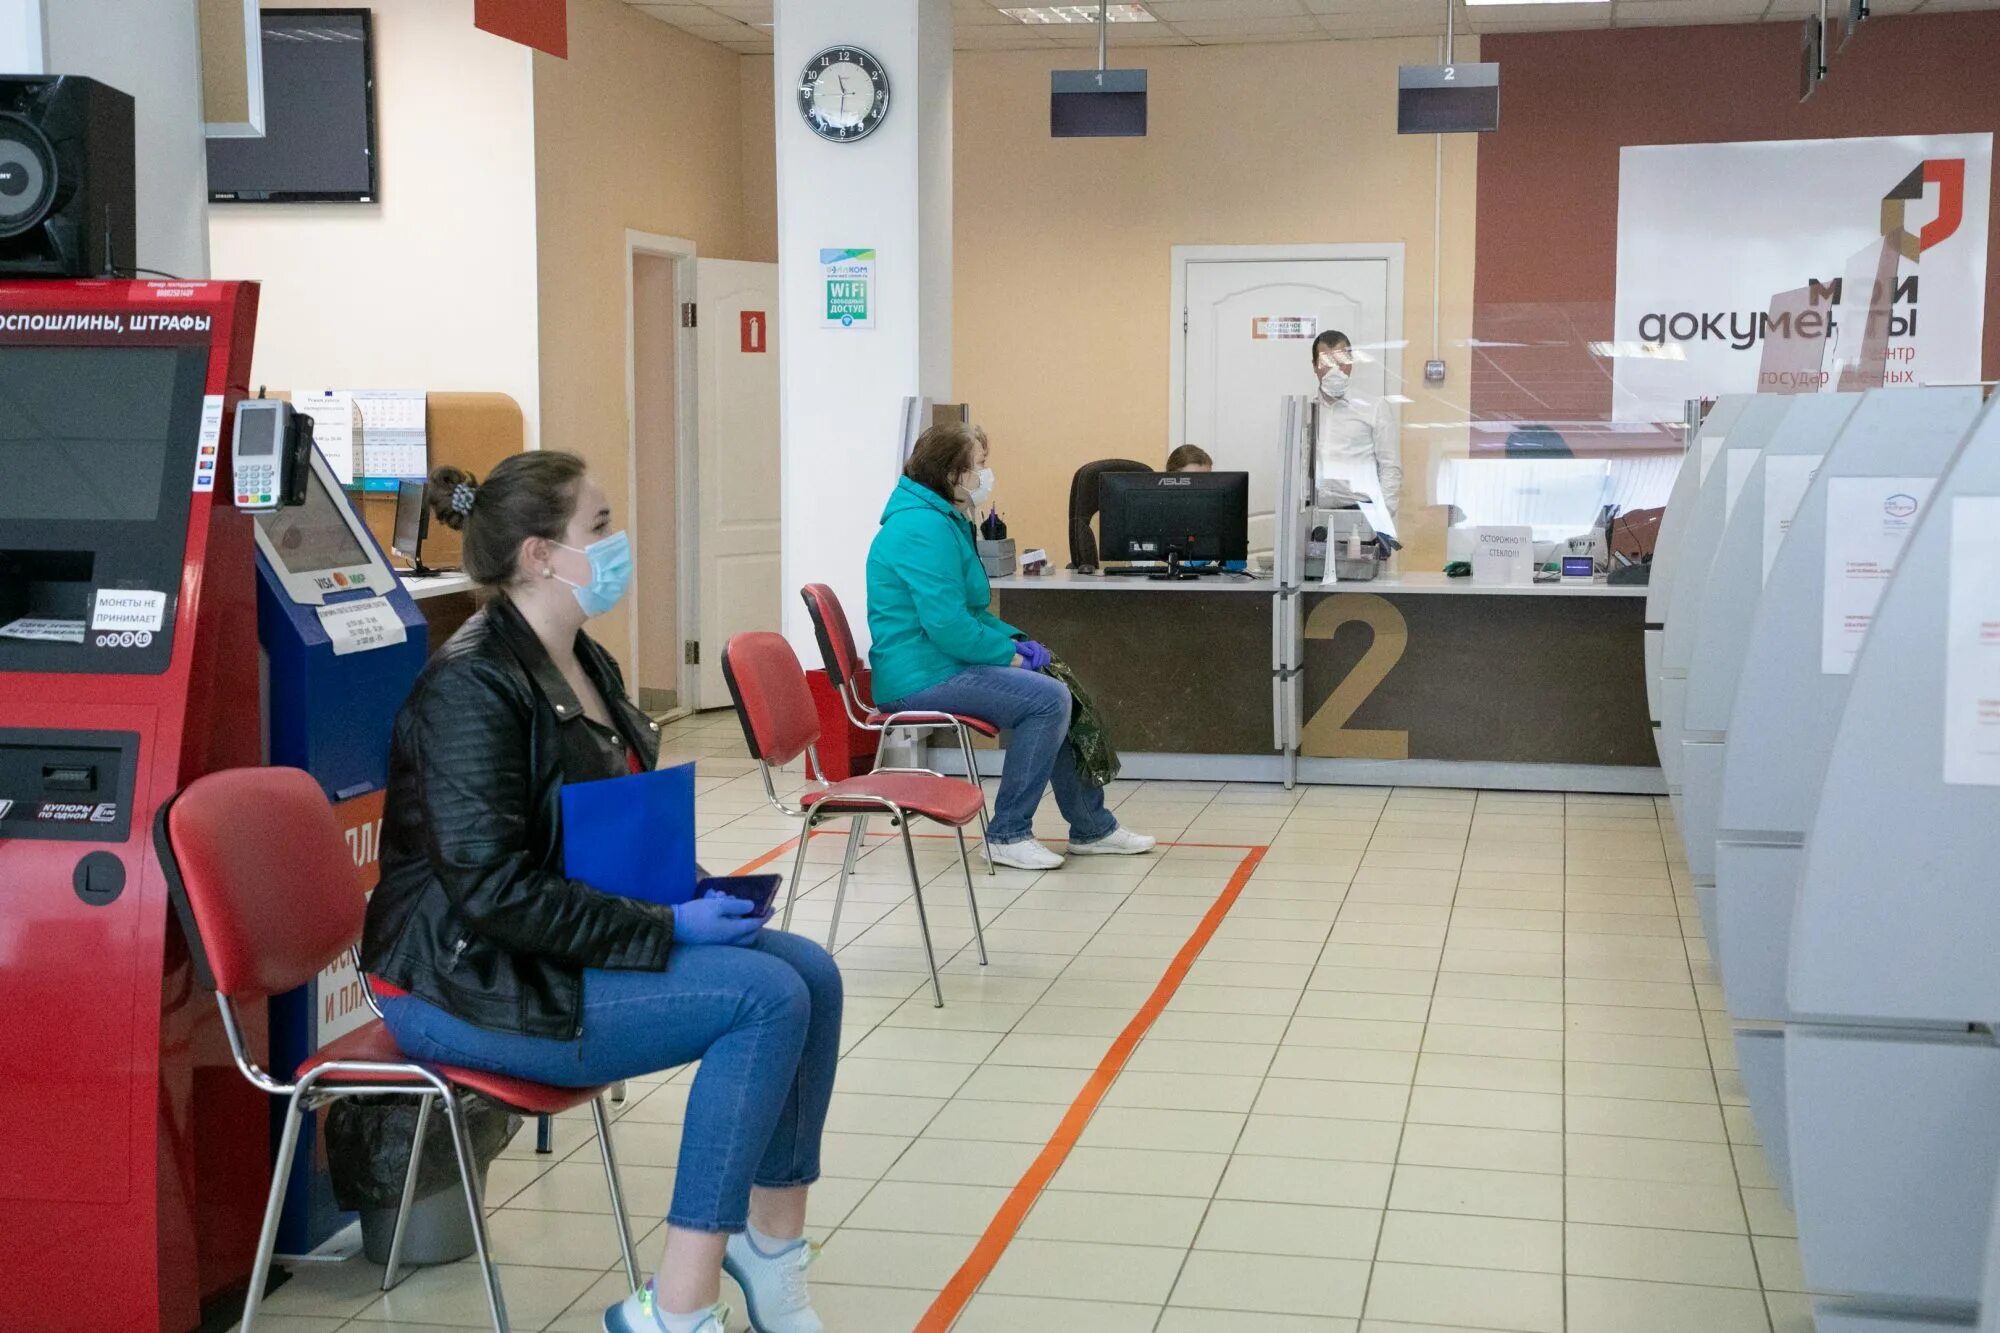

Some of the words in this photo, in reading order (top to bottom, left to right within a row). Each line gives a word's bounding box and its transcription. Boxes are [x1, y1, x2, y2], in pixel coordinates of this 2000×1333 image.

[839, 52, 850, 60] 12
[821, 57, 829, 65] 11
[859, 57, 864, 65] 1
[808, 70, 817, 79] 10
[872, 71, 878, 79] 2
[1444, 67, 1454, 80] 2
[1095, 74, 1102, 85] 1
[804, 90, 810, 98] 9
[876, 90, 882, 99] 3
[809, 109, 815, 117] 8
[872, 109, 877, 118] 4
[840, 128, 845, 136] 6
[830, 283, 864, 297] WiFi
[830, 305, 864, 313] ДОСТУП
[0, 314, 124, 333] СПОШЛИНЫ,
[129, 315, 211, 331] ШТРАФЫ
[1158, 477, 1192, 486] ASUS
[1480, 534, 1519, 544] ОСТОРОЖНО
[314, 577, 336, 590] VISA
[99, 599, 142, 608] МОНЕТЫ
[143, 599, 156, 608] НЕ
[96, 614, 156, 624] ПРИНИМАЕТ
[138, 634, 149, 643] 10
[1302, 592, 1409, 760] 2
[43, 804, 93, 812] КУПЮРЫ
[53, 811, 88, 820] ОДНОЙ
[326, 992, 334, 1024] И
[340, 981, 363, 1016] ПЛ
